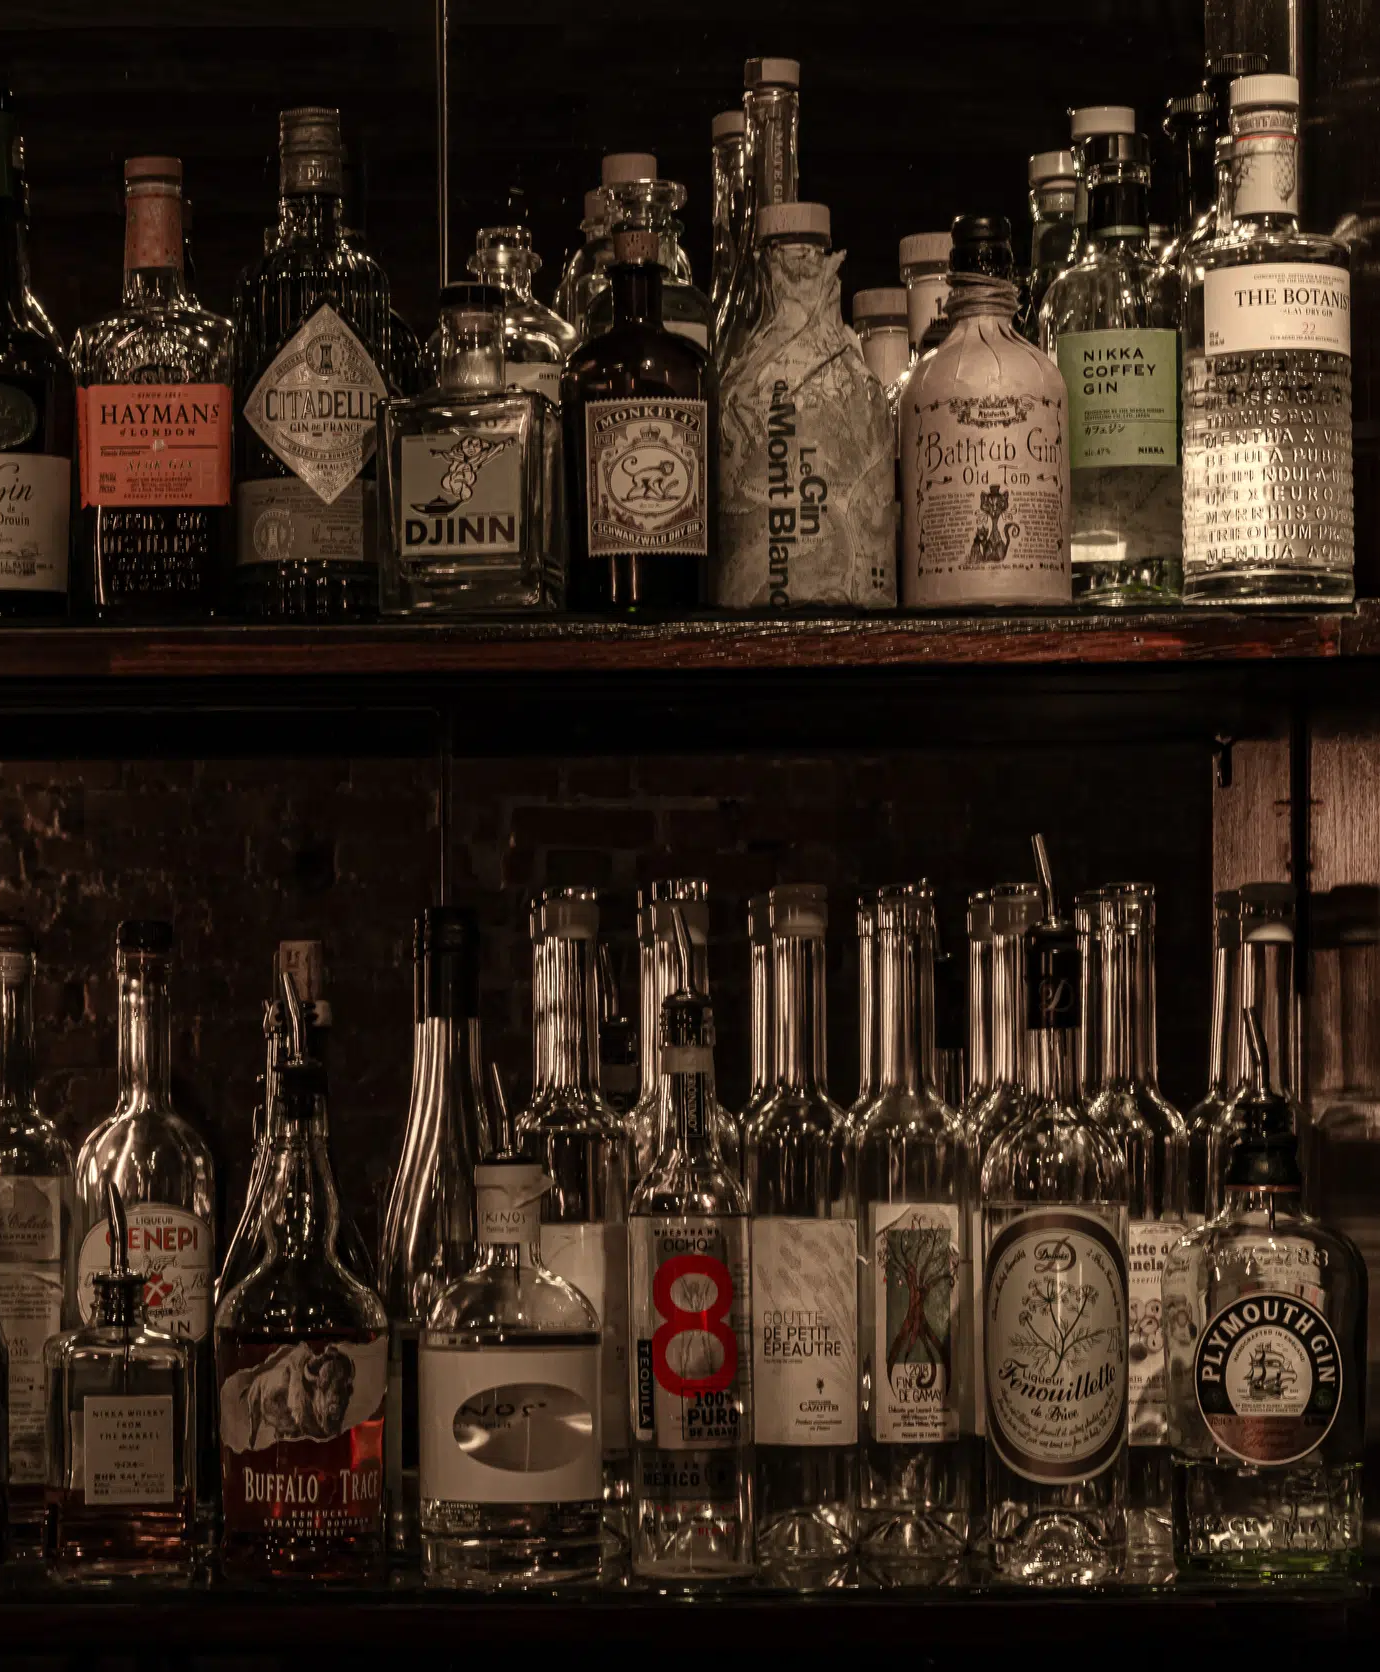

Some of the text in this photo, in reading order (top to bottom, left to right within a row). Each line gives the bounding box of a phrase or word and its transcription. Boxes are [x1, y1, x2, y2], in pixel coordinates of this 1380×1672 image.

[1234, 288, 1277, 308] THE
[1305, 308, 1333, 318] DRY GIN
[1302, 321, 1316, 335] 22
[1083, 347, 1144, 362] NIKKA
[1083, 363, 1156, 379] COFFEY
[1083, 381, 1118, 396] GIN
[600, 405, 698, 430] MONKEY 47
[130, 427, 196, 437] LONDON
[289, 421, 310, 432] GIN
[323, 421, 362, 432] FRANCE
[1205, 427, 1315, 450] MENTHA X
[924, 427, 1058, 475] Bathtub Gin
[1137, 446, 1165, 455] NIKKA
[962, 464, 1031, 487] Old Tom
[799, 447, 828, 536] Le Gin
[7, 503, 16, 513] de
[768, 402, 797, 610] Mont Blanc
[405, 515, 515, 545] DJINN
[597, 522, 700, 547] SCHWARZWALD DRY GIN
[1208, 523, 1312, 544] TRIFOLIUM
[1206, 545, 1295, 565] MENTHA
[135, 1216, 174, 1225] LIQUEUR
[654, 1229, 704, 1237] MUESTRA
[663, 1237, 709, 1253] OCHO
[651, 1254, 738, 1398] 8
[763, 1310, 822, 1326] GOUTTE
[763, 1325, 829, 1341] DE PETIT
[1201, 1300, 1336, 1384] PLYMOUTH GIN
[1232, 1329, 1307, 1363] HANDCRAFTED IN ENGLAND
[909, 1363, 929, 1377] 2018
[1022, 1368, 1065, 1385] Liqueur
[639, 1344, 651, 1425] TEQUILA
[998, 1357, 1117, 1402] Fenouillette
[694, 1390, 734, 1408] 100%
[898, 1388, 943, 1403] DE GAMAY
[92, 1409, 165, 1419] NIKKA WHISKY
[687, 1407, 739, 1426] PURO
[1030, 1406, 1079, 1424] de Brive
[116, 1421, 142, 1429] FROM
[689, 1427, 739, 1437] DE AGAVE
[100, 1431, 160, 1441] THE BARREL
[243, 1466, 379, 1504] BUFFALO TRACE
[291, 1508, 349, 1519] KENTUCKY
[263, 1516, 369, 1529] STRAIGHT BOURBON
[296, 1528, 345, 1538] WHISKEY
